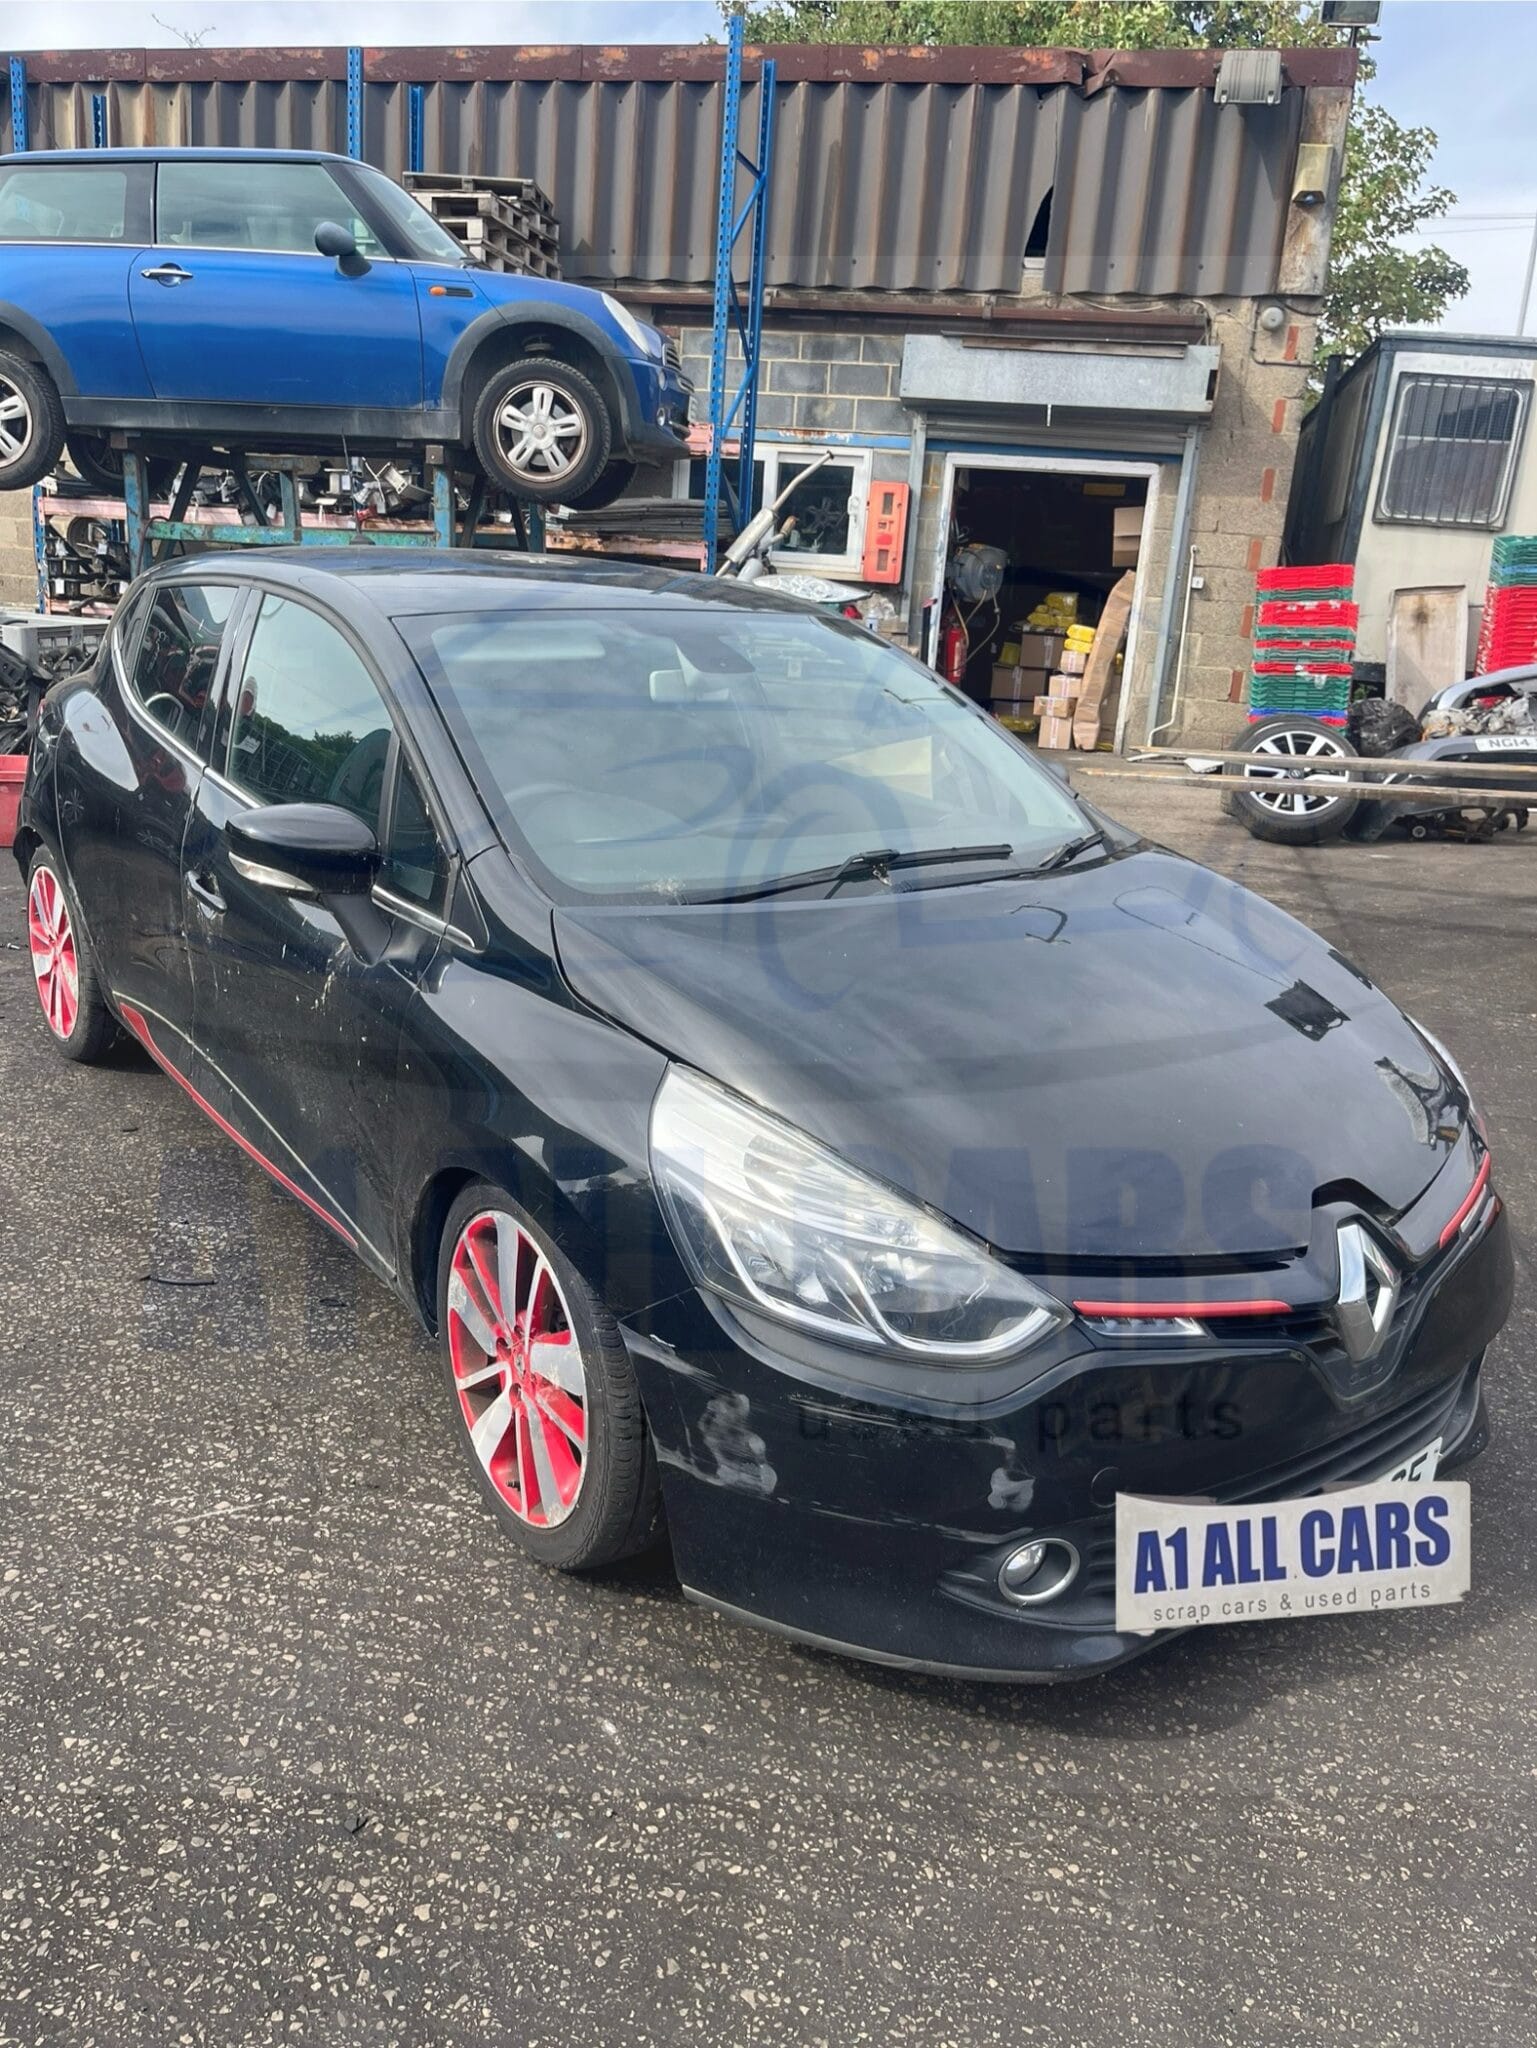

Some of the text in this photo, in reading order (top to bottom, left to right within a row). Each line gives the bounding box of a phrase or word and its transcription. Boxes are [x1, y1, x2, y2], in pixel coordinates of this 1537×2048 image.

[1489, 739, 1530, 748] NG14
[1134, 1495, 1451, 1594] A1 ALL CARS
[1154, 1582, 1431, 1621] scrap cars & used parts
